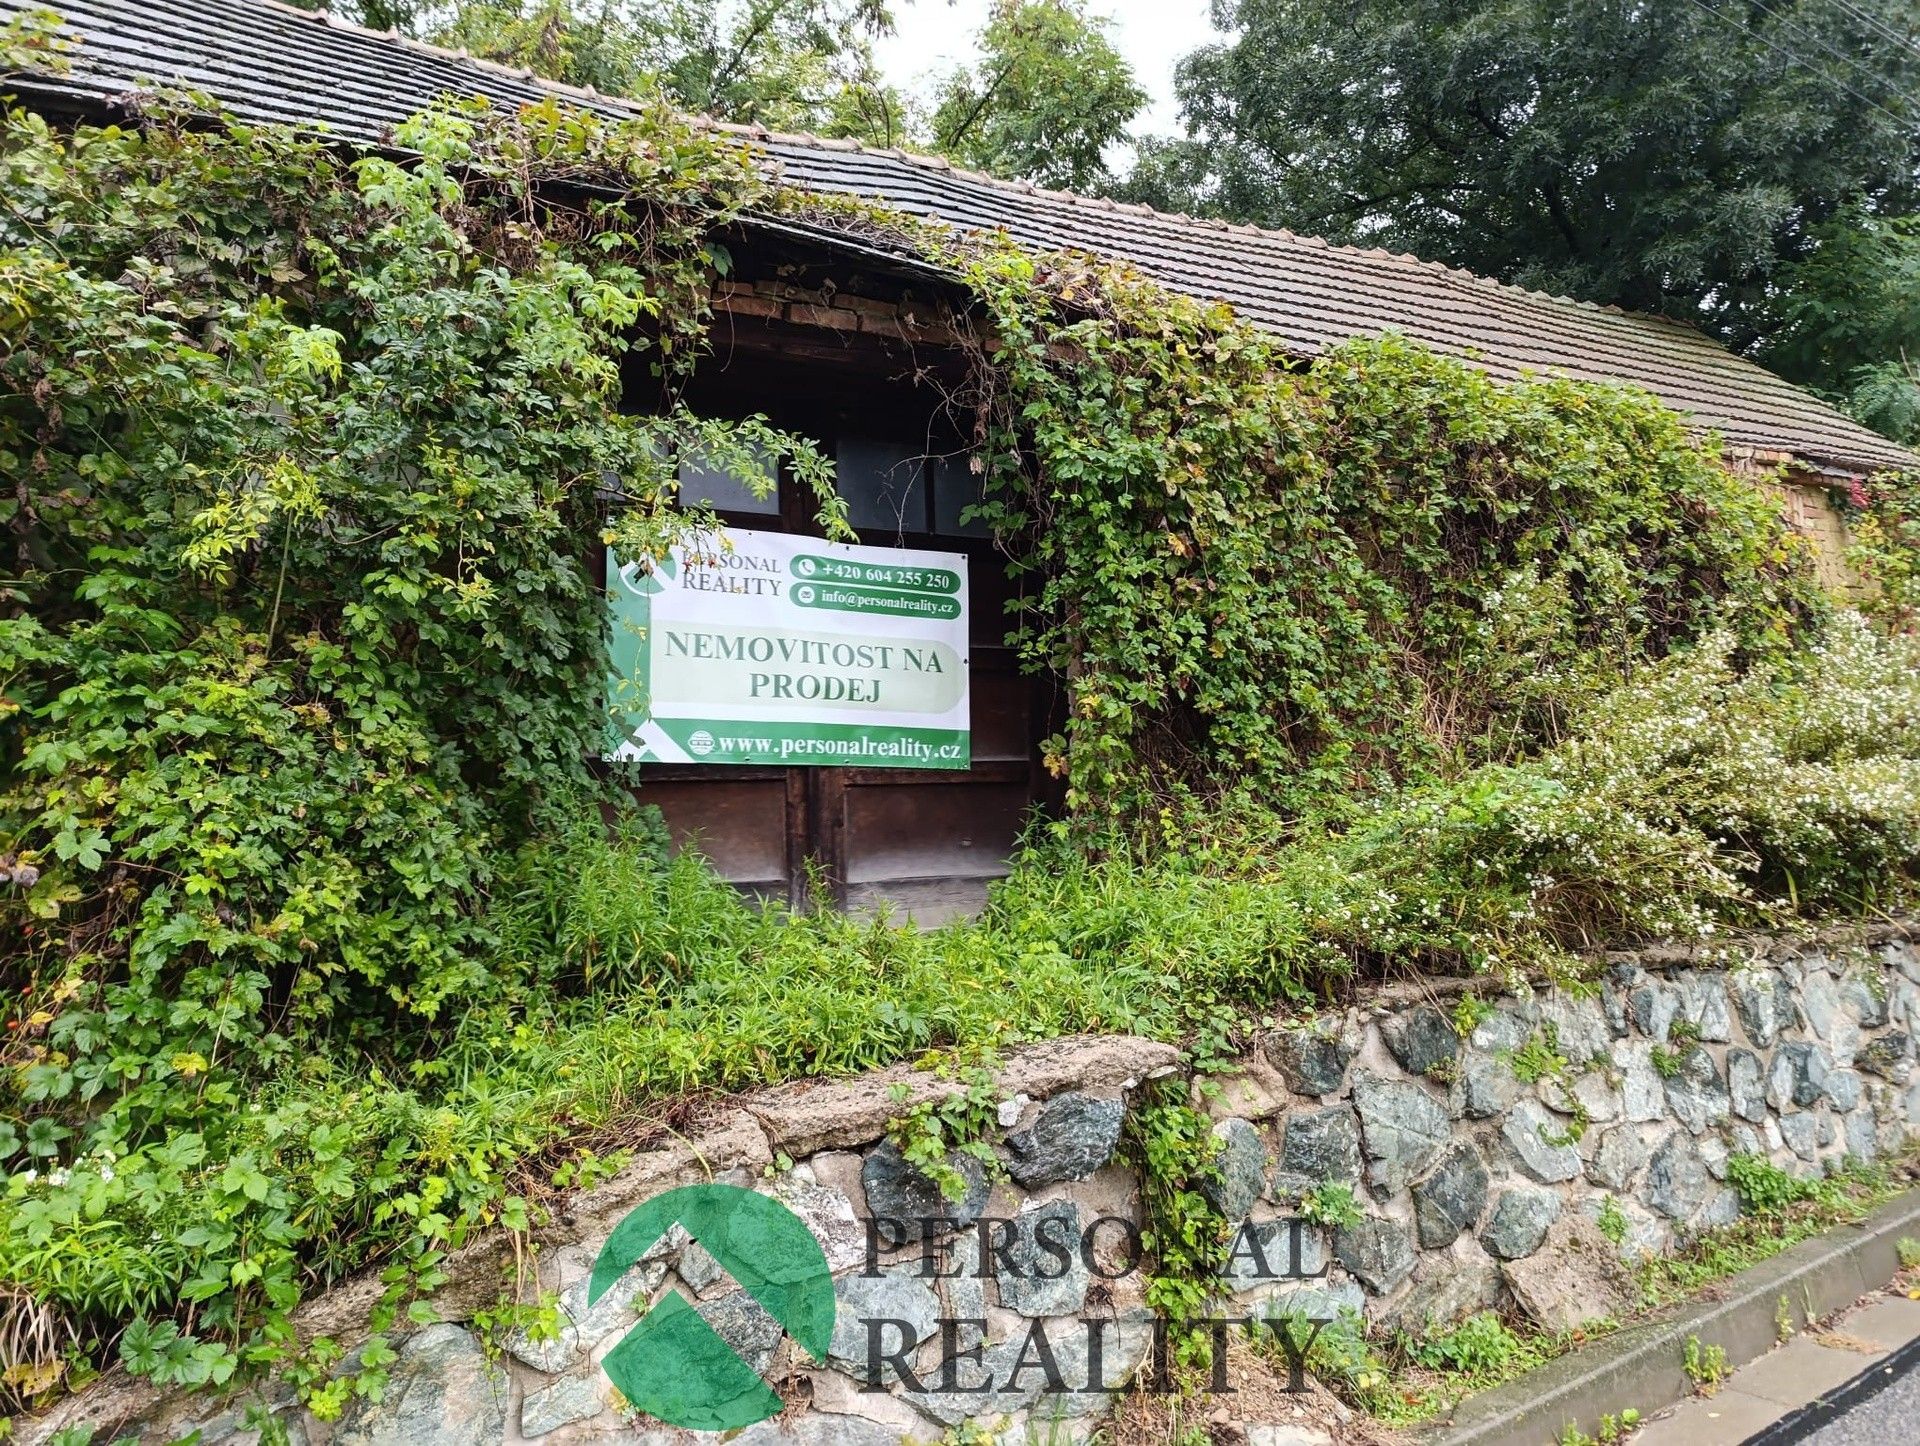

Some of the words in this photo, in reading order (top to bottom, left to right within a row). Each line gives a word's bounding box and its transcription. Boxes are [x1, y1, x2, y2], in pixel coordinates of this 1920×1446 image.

[682, 550, 782, 574] RSONAL
[682, 571, 782, 597] REALITY
[823, 563, 861, 580] +420
[866, 568, 893, 583] 604
[896, 571, 922, 586] 255
[926, 573, 950, 589] 250
[821, 590, 954, 615] info@personalreality.cz
[664, 631, 894, 670] NEMOVITOST
[902, 648, 944, 674] NA
[749, 672, 881, 704] PRODEJ
[718, 735, 961, 763] www.personalreality.cz
